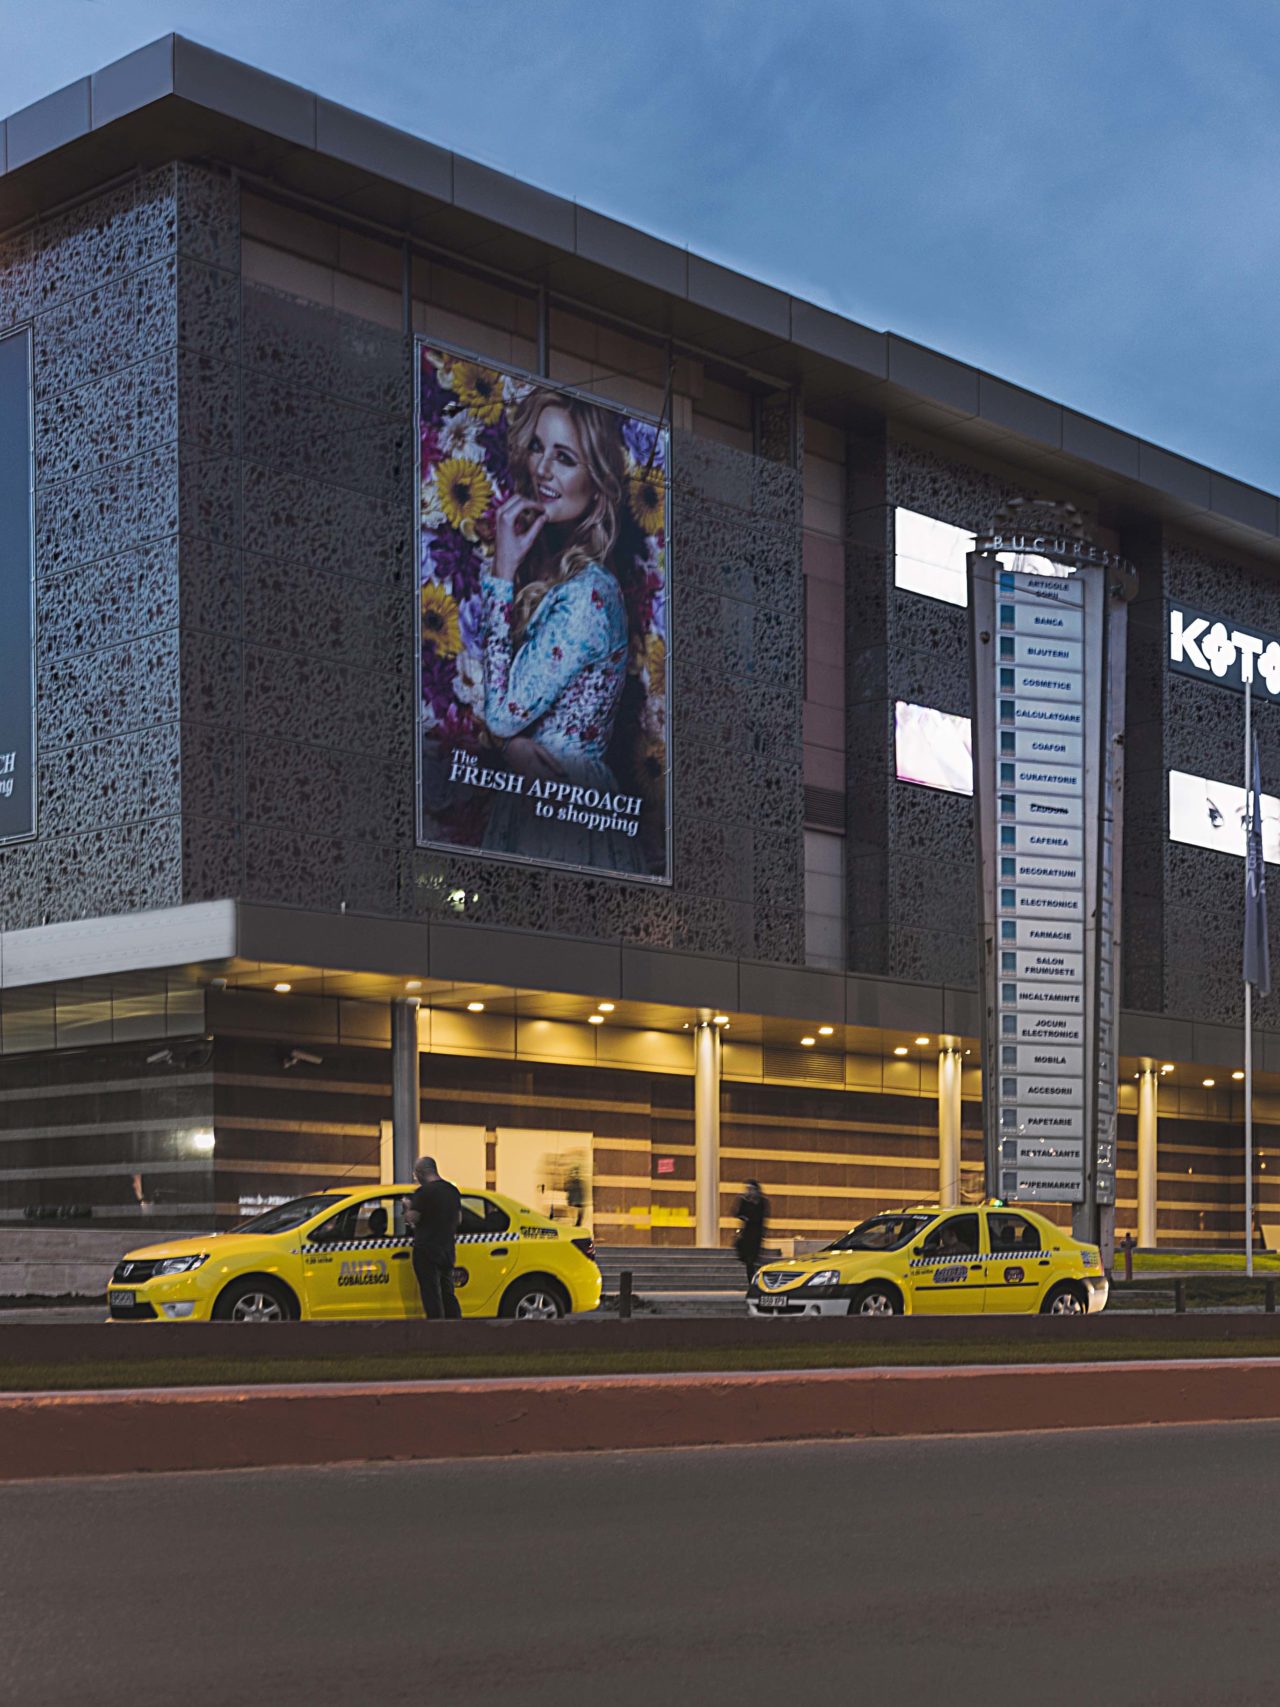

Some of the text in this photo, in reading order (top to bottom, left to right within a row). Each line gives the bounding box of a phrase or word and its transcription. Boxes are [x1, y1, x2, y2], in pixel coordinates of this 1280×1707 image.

[1034, 616, 1064, 628] BANCA
[1027, 647, 1070, 659] BIJUTERII
[1022, 679, 1072, 691] COSMETICE
[1015, 709, 1081, 723] CALCULATOARE
[1031, 741, 1066, 753] COAFOR
[450, 748, 478, 766] The
[1019, 773, 1077, 785] CURATATORIE
[448, 764, 642, 816] FRESH APPROACH
[535, 801, 639, 837] to shopping
[1030, 836, 1069, 846] CAFENEA
[1020, 867, 1077, 878] DECORATIUNI
[1020, 898, 1079, 909] ELECTRONICE
[1029, 930, 1072, 941] FARMACIE
[1036, 957, 1065, 966] SALON
[1025, 966, 1075, 977] FRUMUSETE
[1019, 992, 1081, 1003] INCALTAMINTE
[1034, 1019, 1067, 1029] JOCURI
[1021, 1029, 1079, 1039] ELECTRONICE
[1034, 1055, 1067, 1065] MOBILA
[1027, 1086, 1073, 1096] ACCESORII
[1027, 1117, 1073, 1127] PAPETARIE
[1019, 1181, 1081, 1191] SUPERMARKET
[340, 1259, 387, 1276] AUTO
